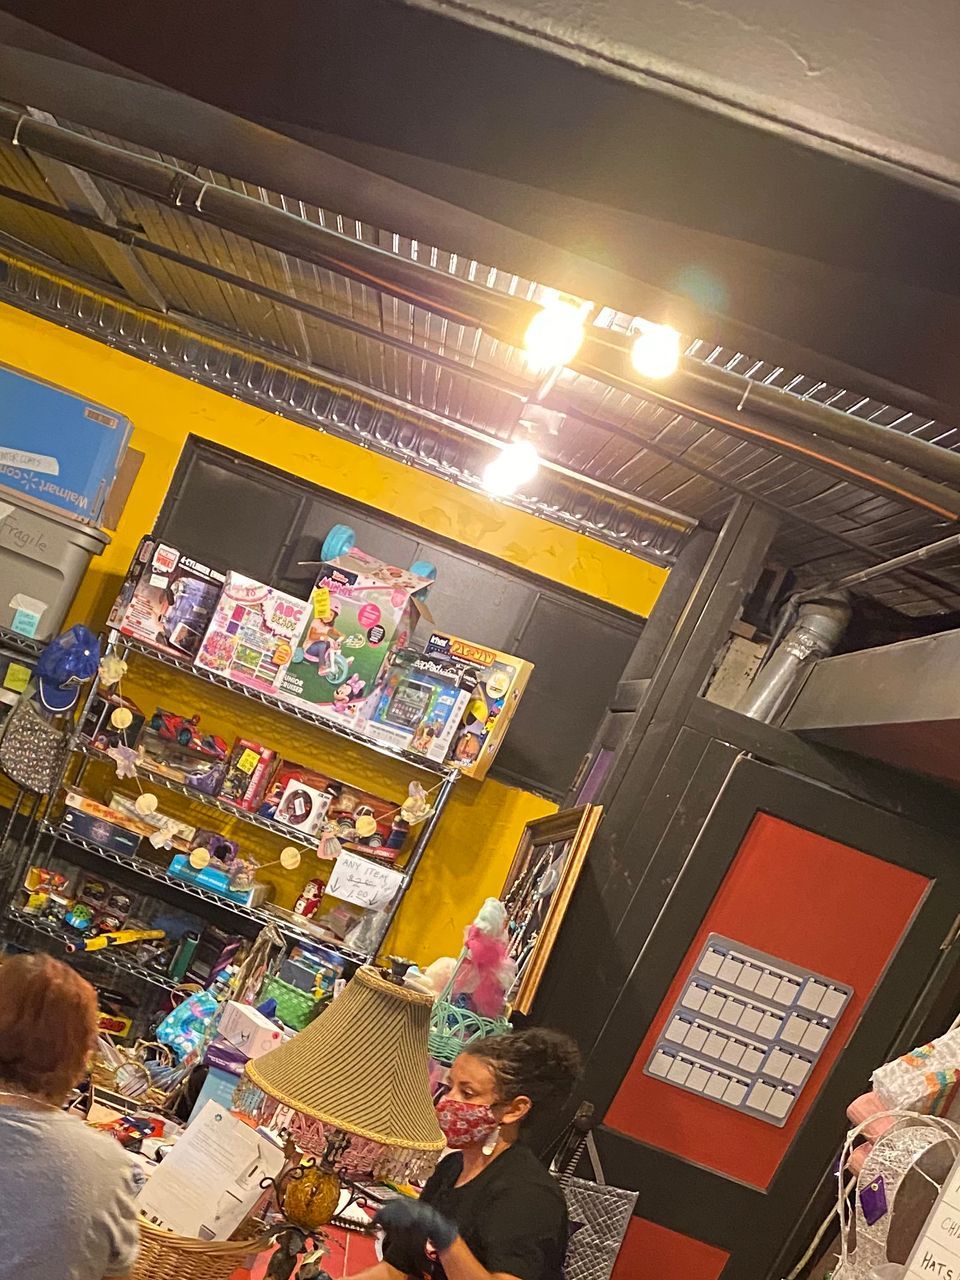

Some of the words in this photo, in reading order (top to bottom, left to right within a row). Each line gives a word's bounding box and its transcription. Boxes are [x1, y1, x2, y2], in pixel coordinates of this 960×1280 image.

[39, 483, 88, 509] Walmart
[1, 514, 48, 551] Fragile
[274, 601, 304, 622] ABC
[453, 641, 495, 665] PAC-MAN
[411, 659, 442, 675] eapPad
[284, 675, 304, 687] UNIOR
[343, 859, 362, 870] ANY
[365, 867, 389, 882] ITEM
